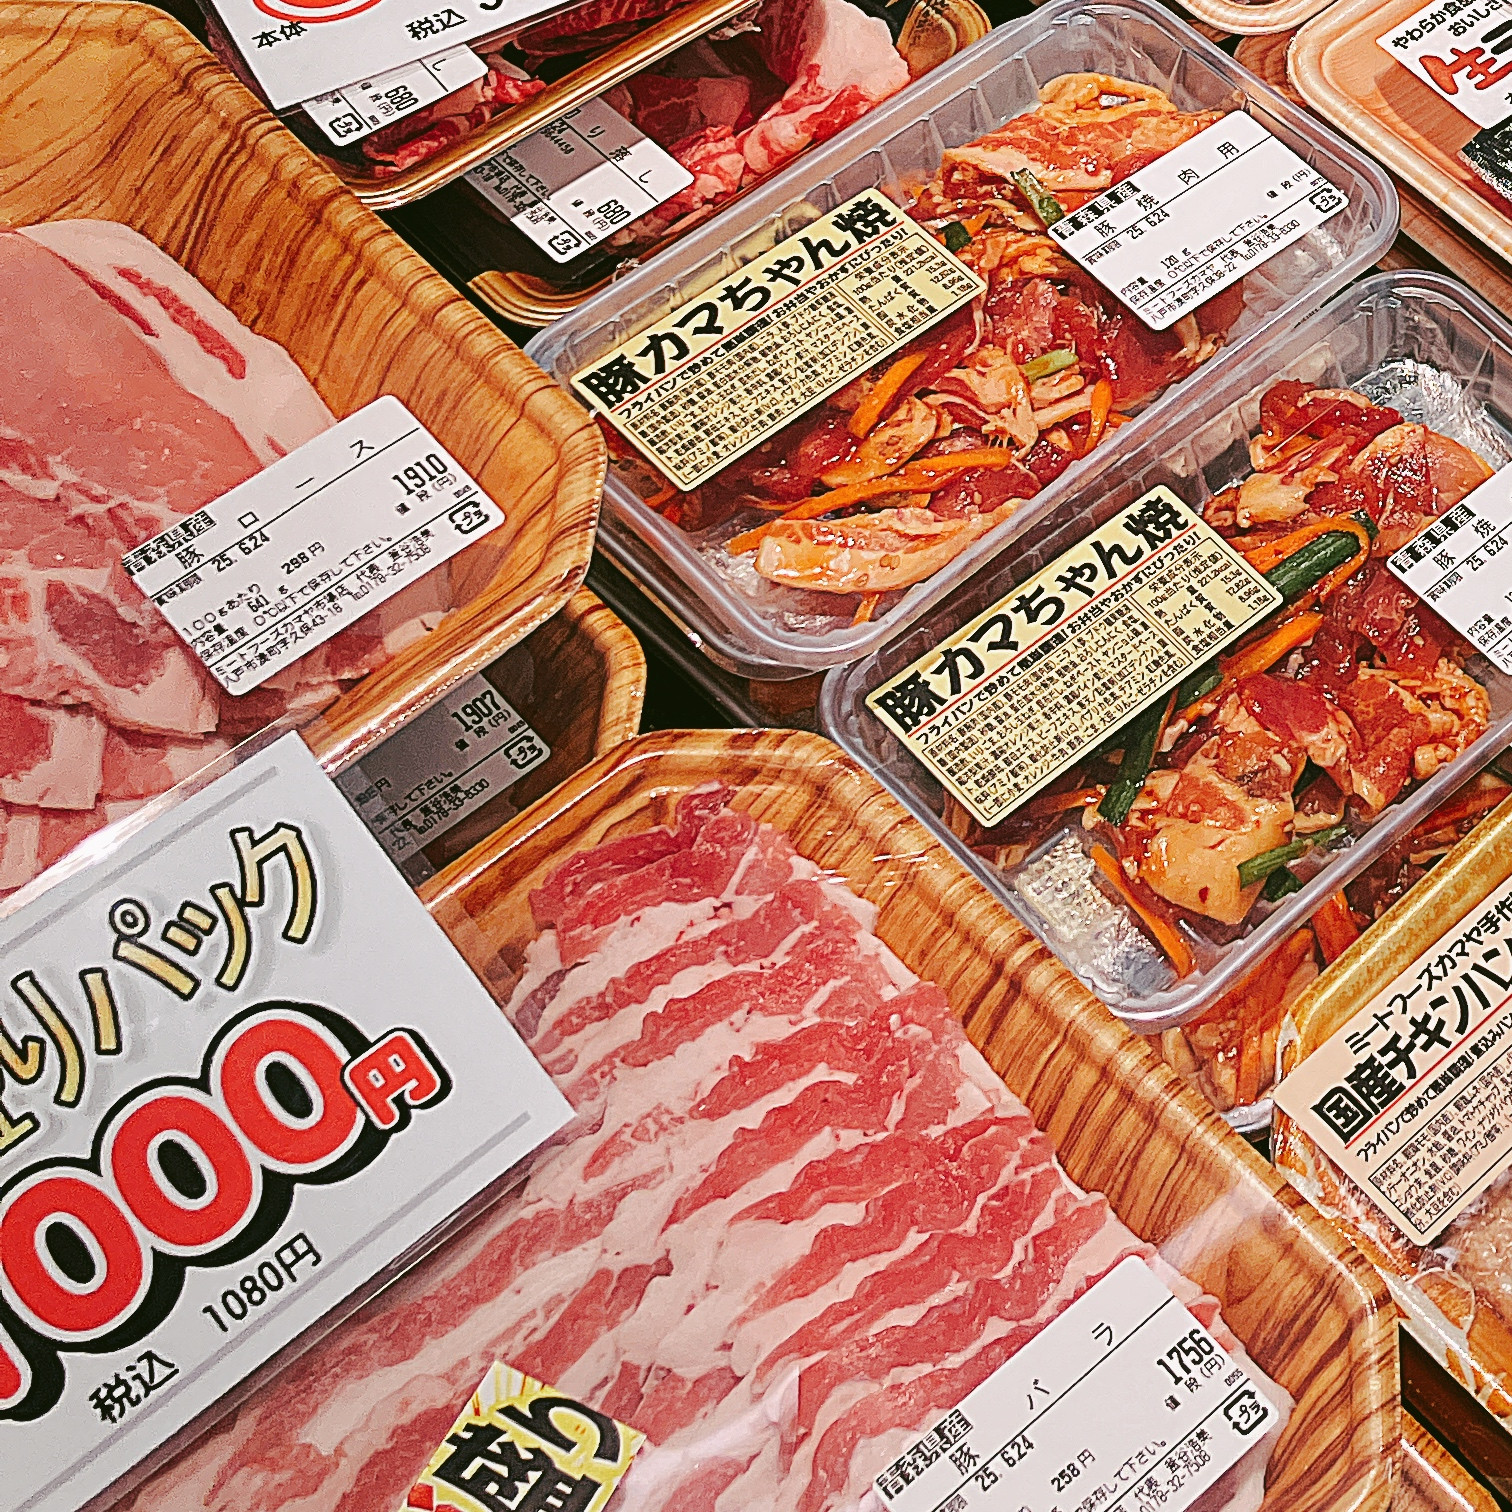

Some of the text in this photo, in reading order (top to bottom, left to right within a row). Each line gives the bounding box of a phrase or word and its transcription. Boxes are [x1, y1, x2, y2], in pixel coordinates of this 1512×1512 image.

[251, 22, 304, 49] 本体
[406, 9, 468, 40] 税込
[384, 85, 417, 111] 680
[597, 199, 631, 226] 680
[1094, 141, 1240, 238] 豚焼肉用
[581, 198, 899, 409] 豚カマちゃん焼
[179, 440, 374, 569] 豚ロース
[392, 453, 449, 497] 1910
[875, 496, 1189, 734] 豚カマちゃん焼
[451, 689, 502, 732] 1907
[0, 822, 317, 1150] りパック
[0, 1001, 453, 1420] 000円
[88, 1232, 322, 1424] 税込 1080円
[1157, 1329, 1215, 1384] 1756
[949, 1322, 1118, 1475] 豚バラ
